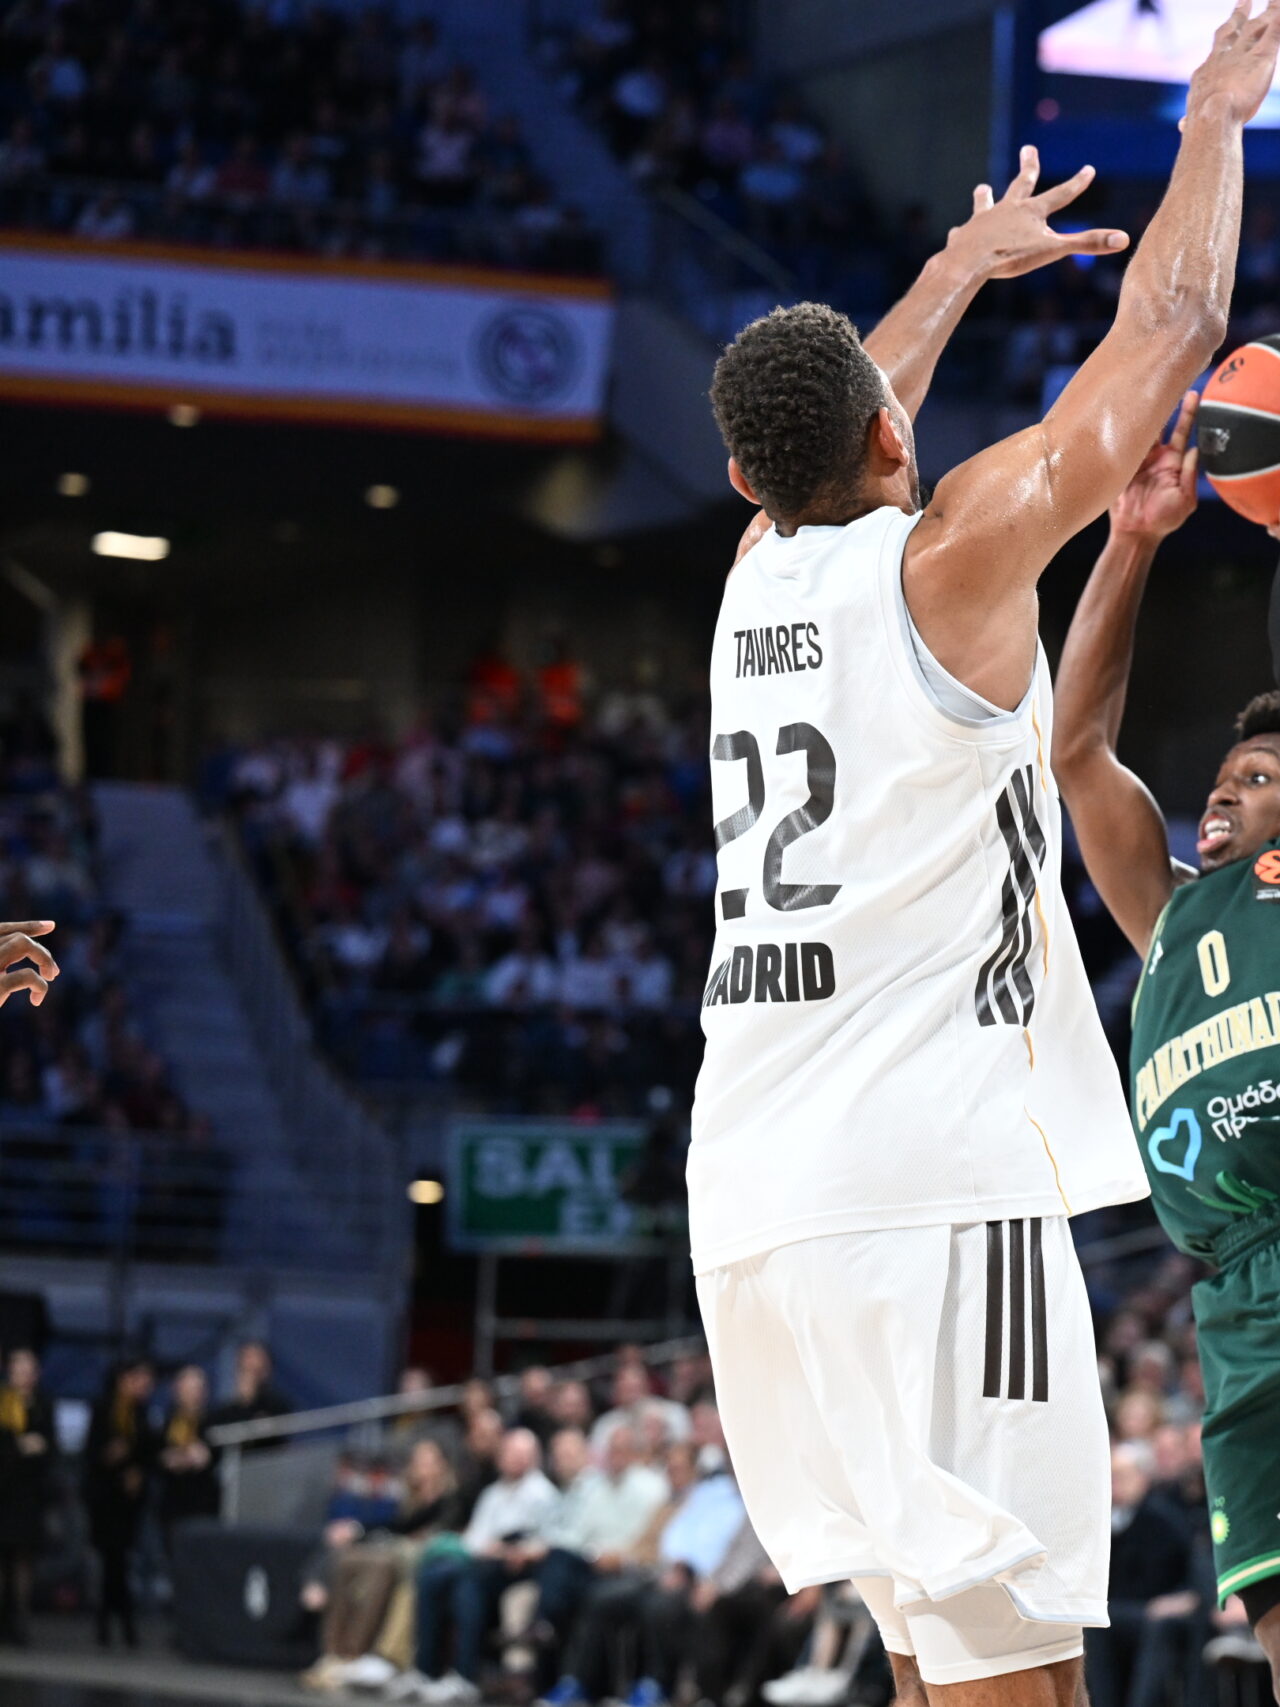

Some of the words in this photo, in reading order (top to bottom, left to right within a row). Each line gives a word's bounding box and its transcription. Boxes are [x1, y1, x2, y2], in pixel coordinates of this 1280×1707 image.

[733, 621, 823, 678] TAVARES
[711, 721, 843, 921] 22
[702, 941, 836, 1008] ADRID
[1196, 929, 1231, 998] 0
